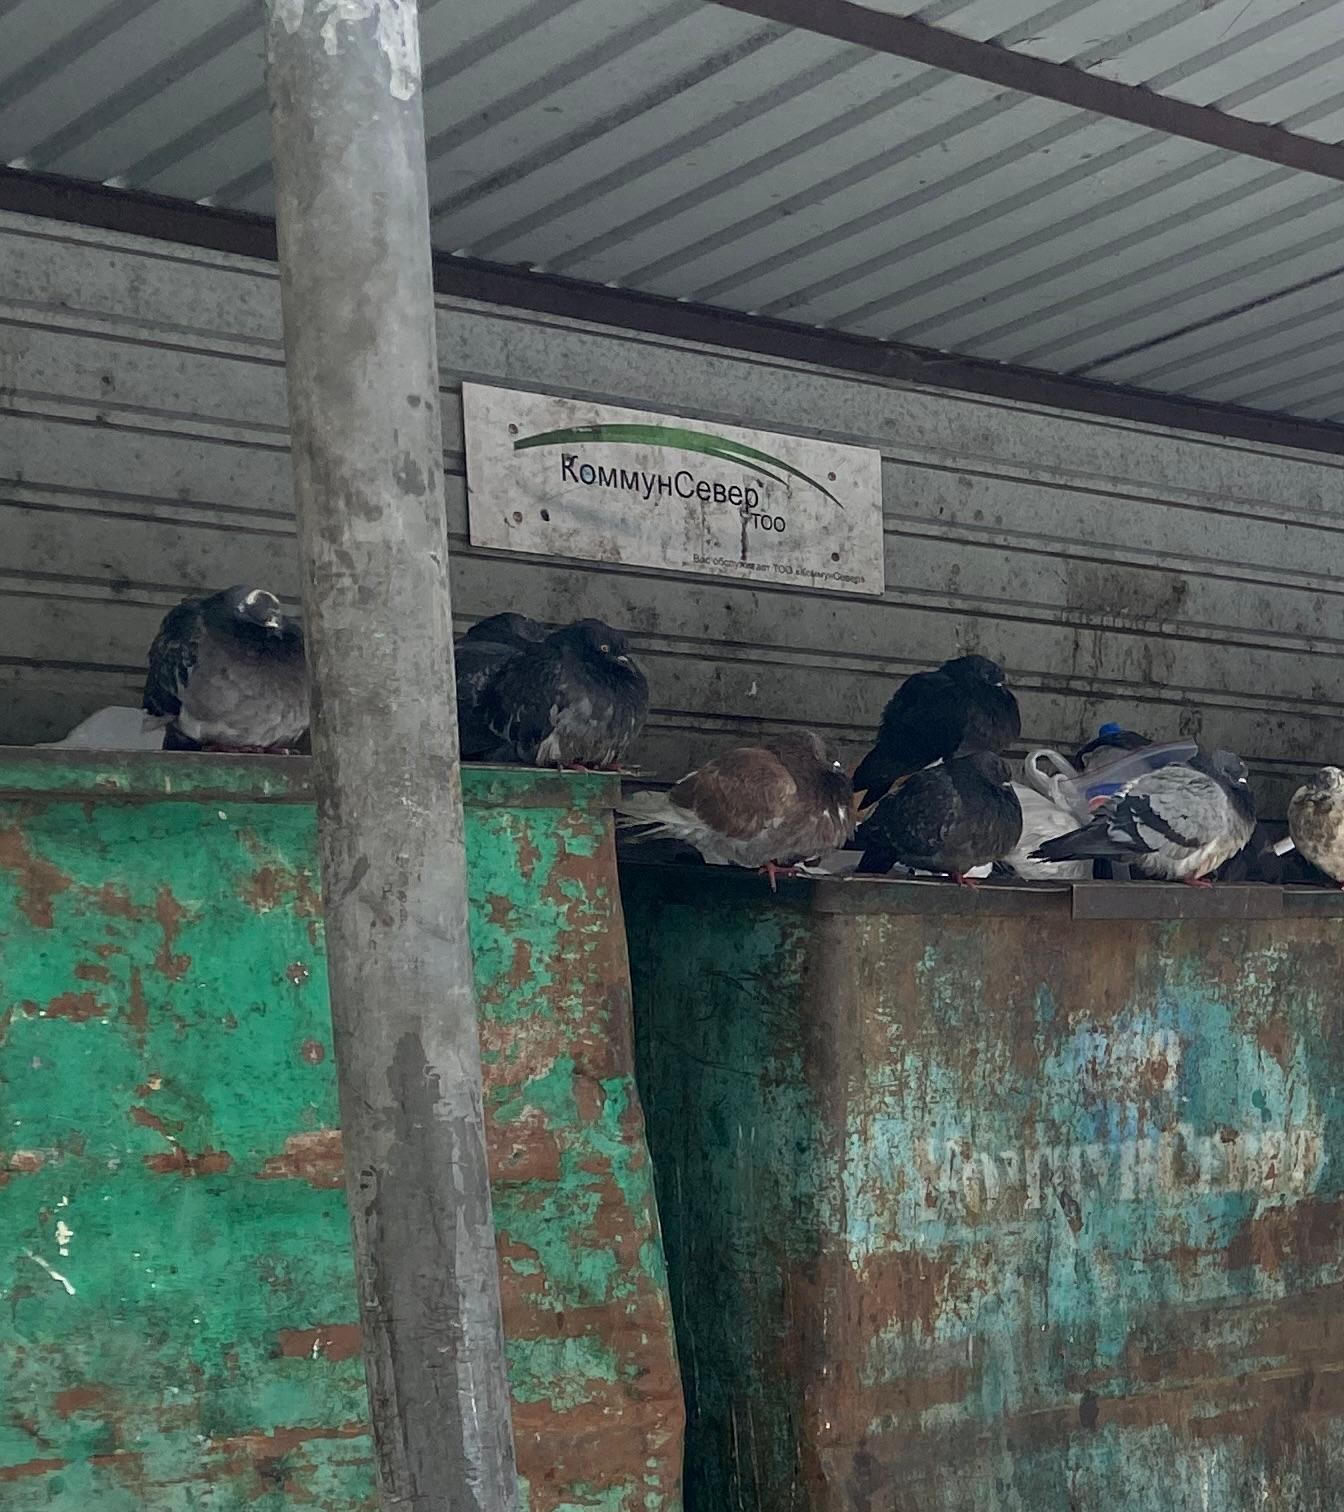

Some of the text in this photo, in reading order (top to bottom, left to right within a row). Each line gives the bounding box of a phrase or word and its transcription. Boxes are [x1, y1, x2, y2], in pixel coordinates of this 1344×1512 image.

[562, 453, 759, 513] КоммунСевер
[692, 553, 711, 565] Вас
[773, 565, 793, 575] ТОО
